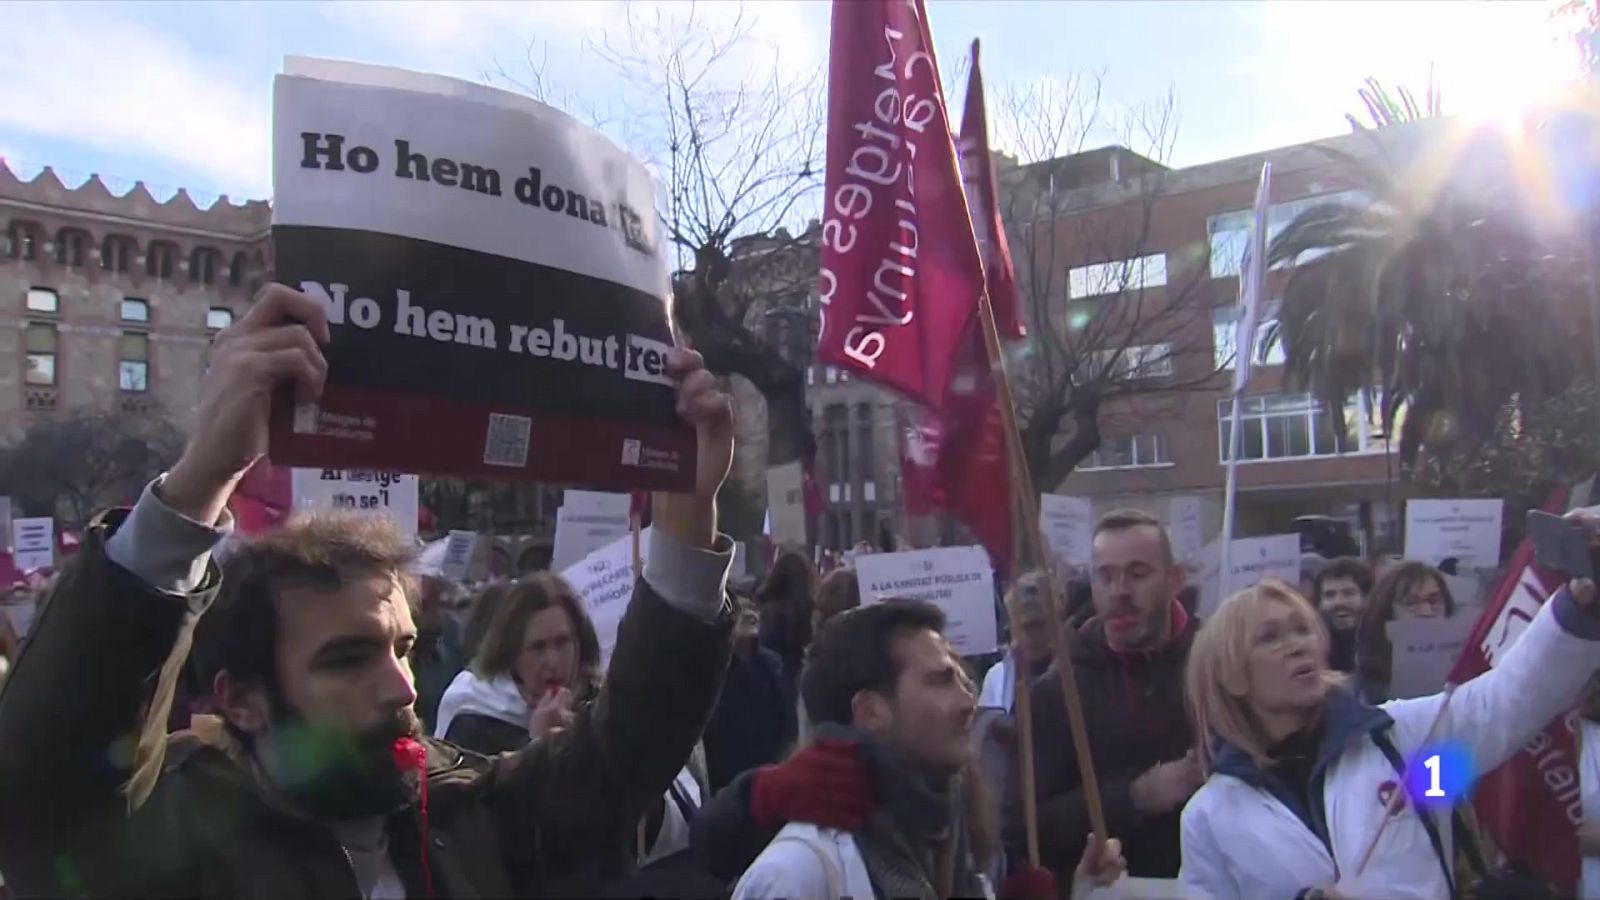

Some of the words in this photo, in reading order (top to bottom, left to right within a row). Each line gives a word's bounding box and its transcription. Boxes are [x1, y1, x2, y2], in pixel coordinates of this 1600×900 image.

[300, 132, 379, 173] Ho
[394, 140, 501, 197] hem
[514, 167, 617, 231] dona
[300, 281, 381, 330] No
[394, 290, 497, 348] hem
[509, 319, 619, 370] rebut
